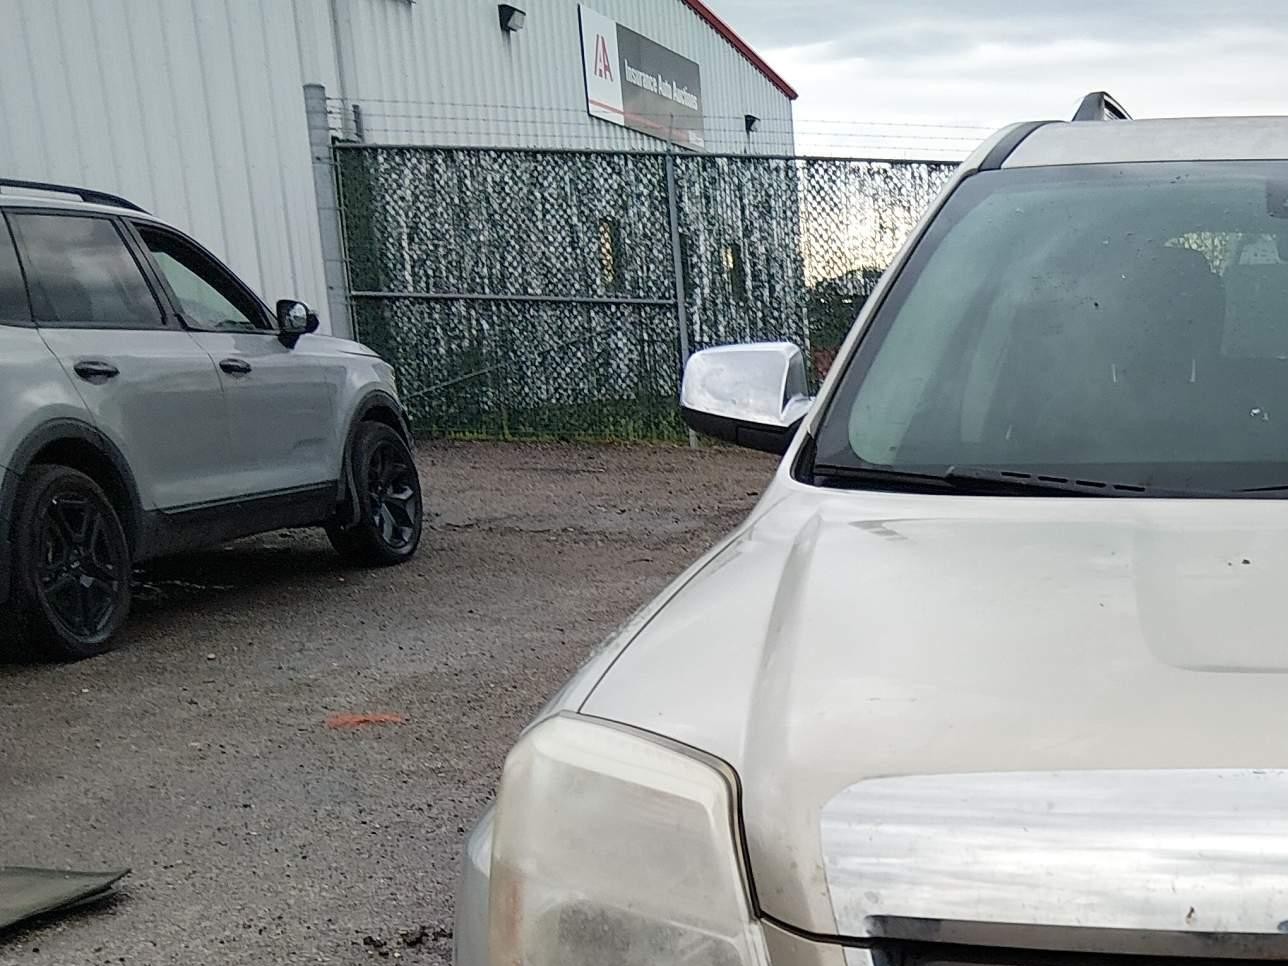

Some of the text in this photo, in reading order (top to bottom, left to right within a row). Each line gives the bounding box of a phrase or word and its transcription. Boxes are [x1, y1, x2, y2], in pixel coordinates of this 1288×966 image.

[624, 58, 698, 112] Insurance Auto Auctions
